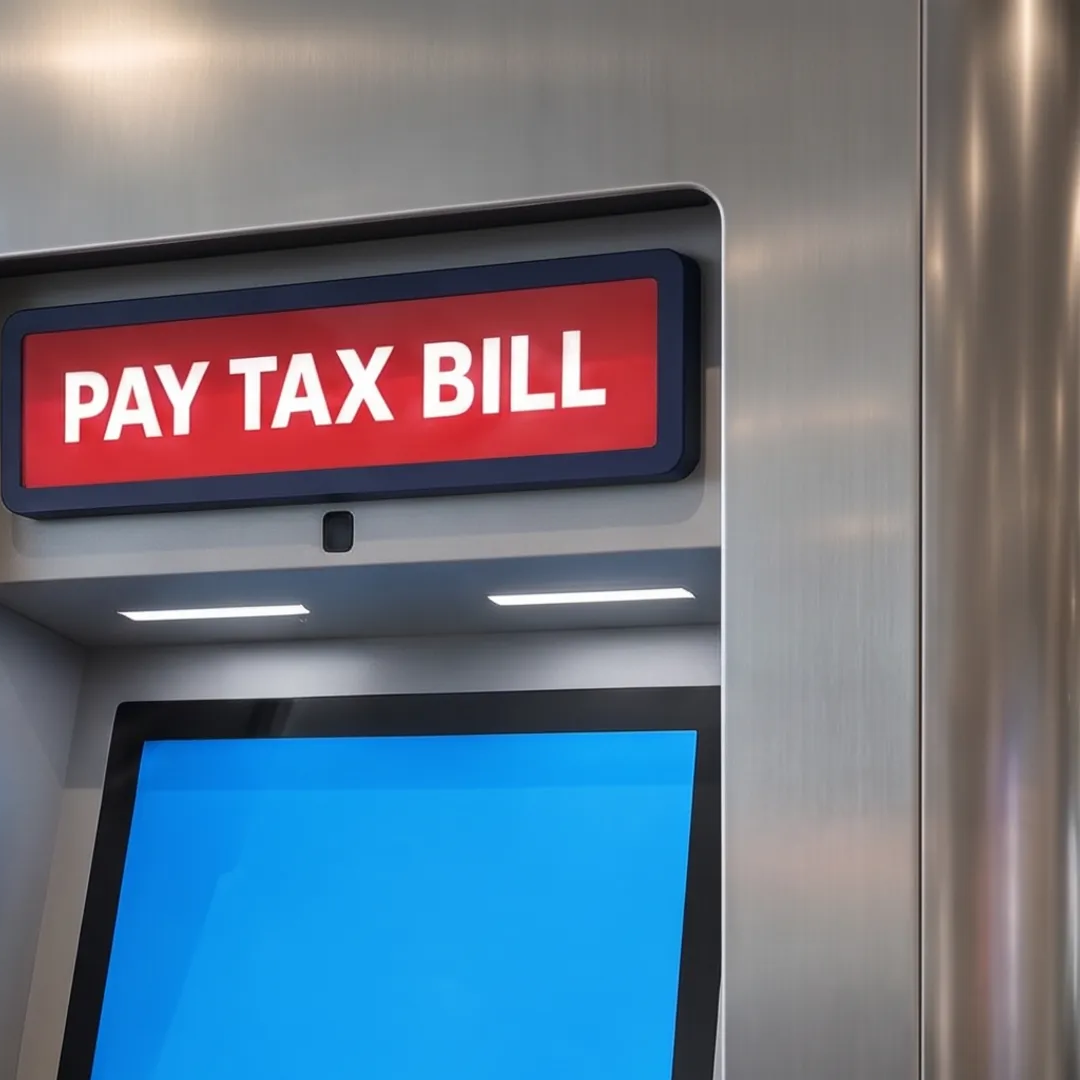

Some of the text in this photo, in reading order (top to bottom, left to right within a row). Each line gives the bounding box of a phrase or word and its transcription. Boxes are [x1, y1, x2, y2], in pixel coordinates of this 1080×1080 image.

[64, 330, 607, 443] PAY TAX BILL
